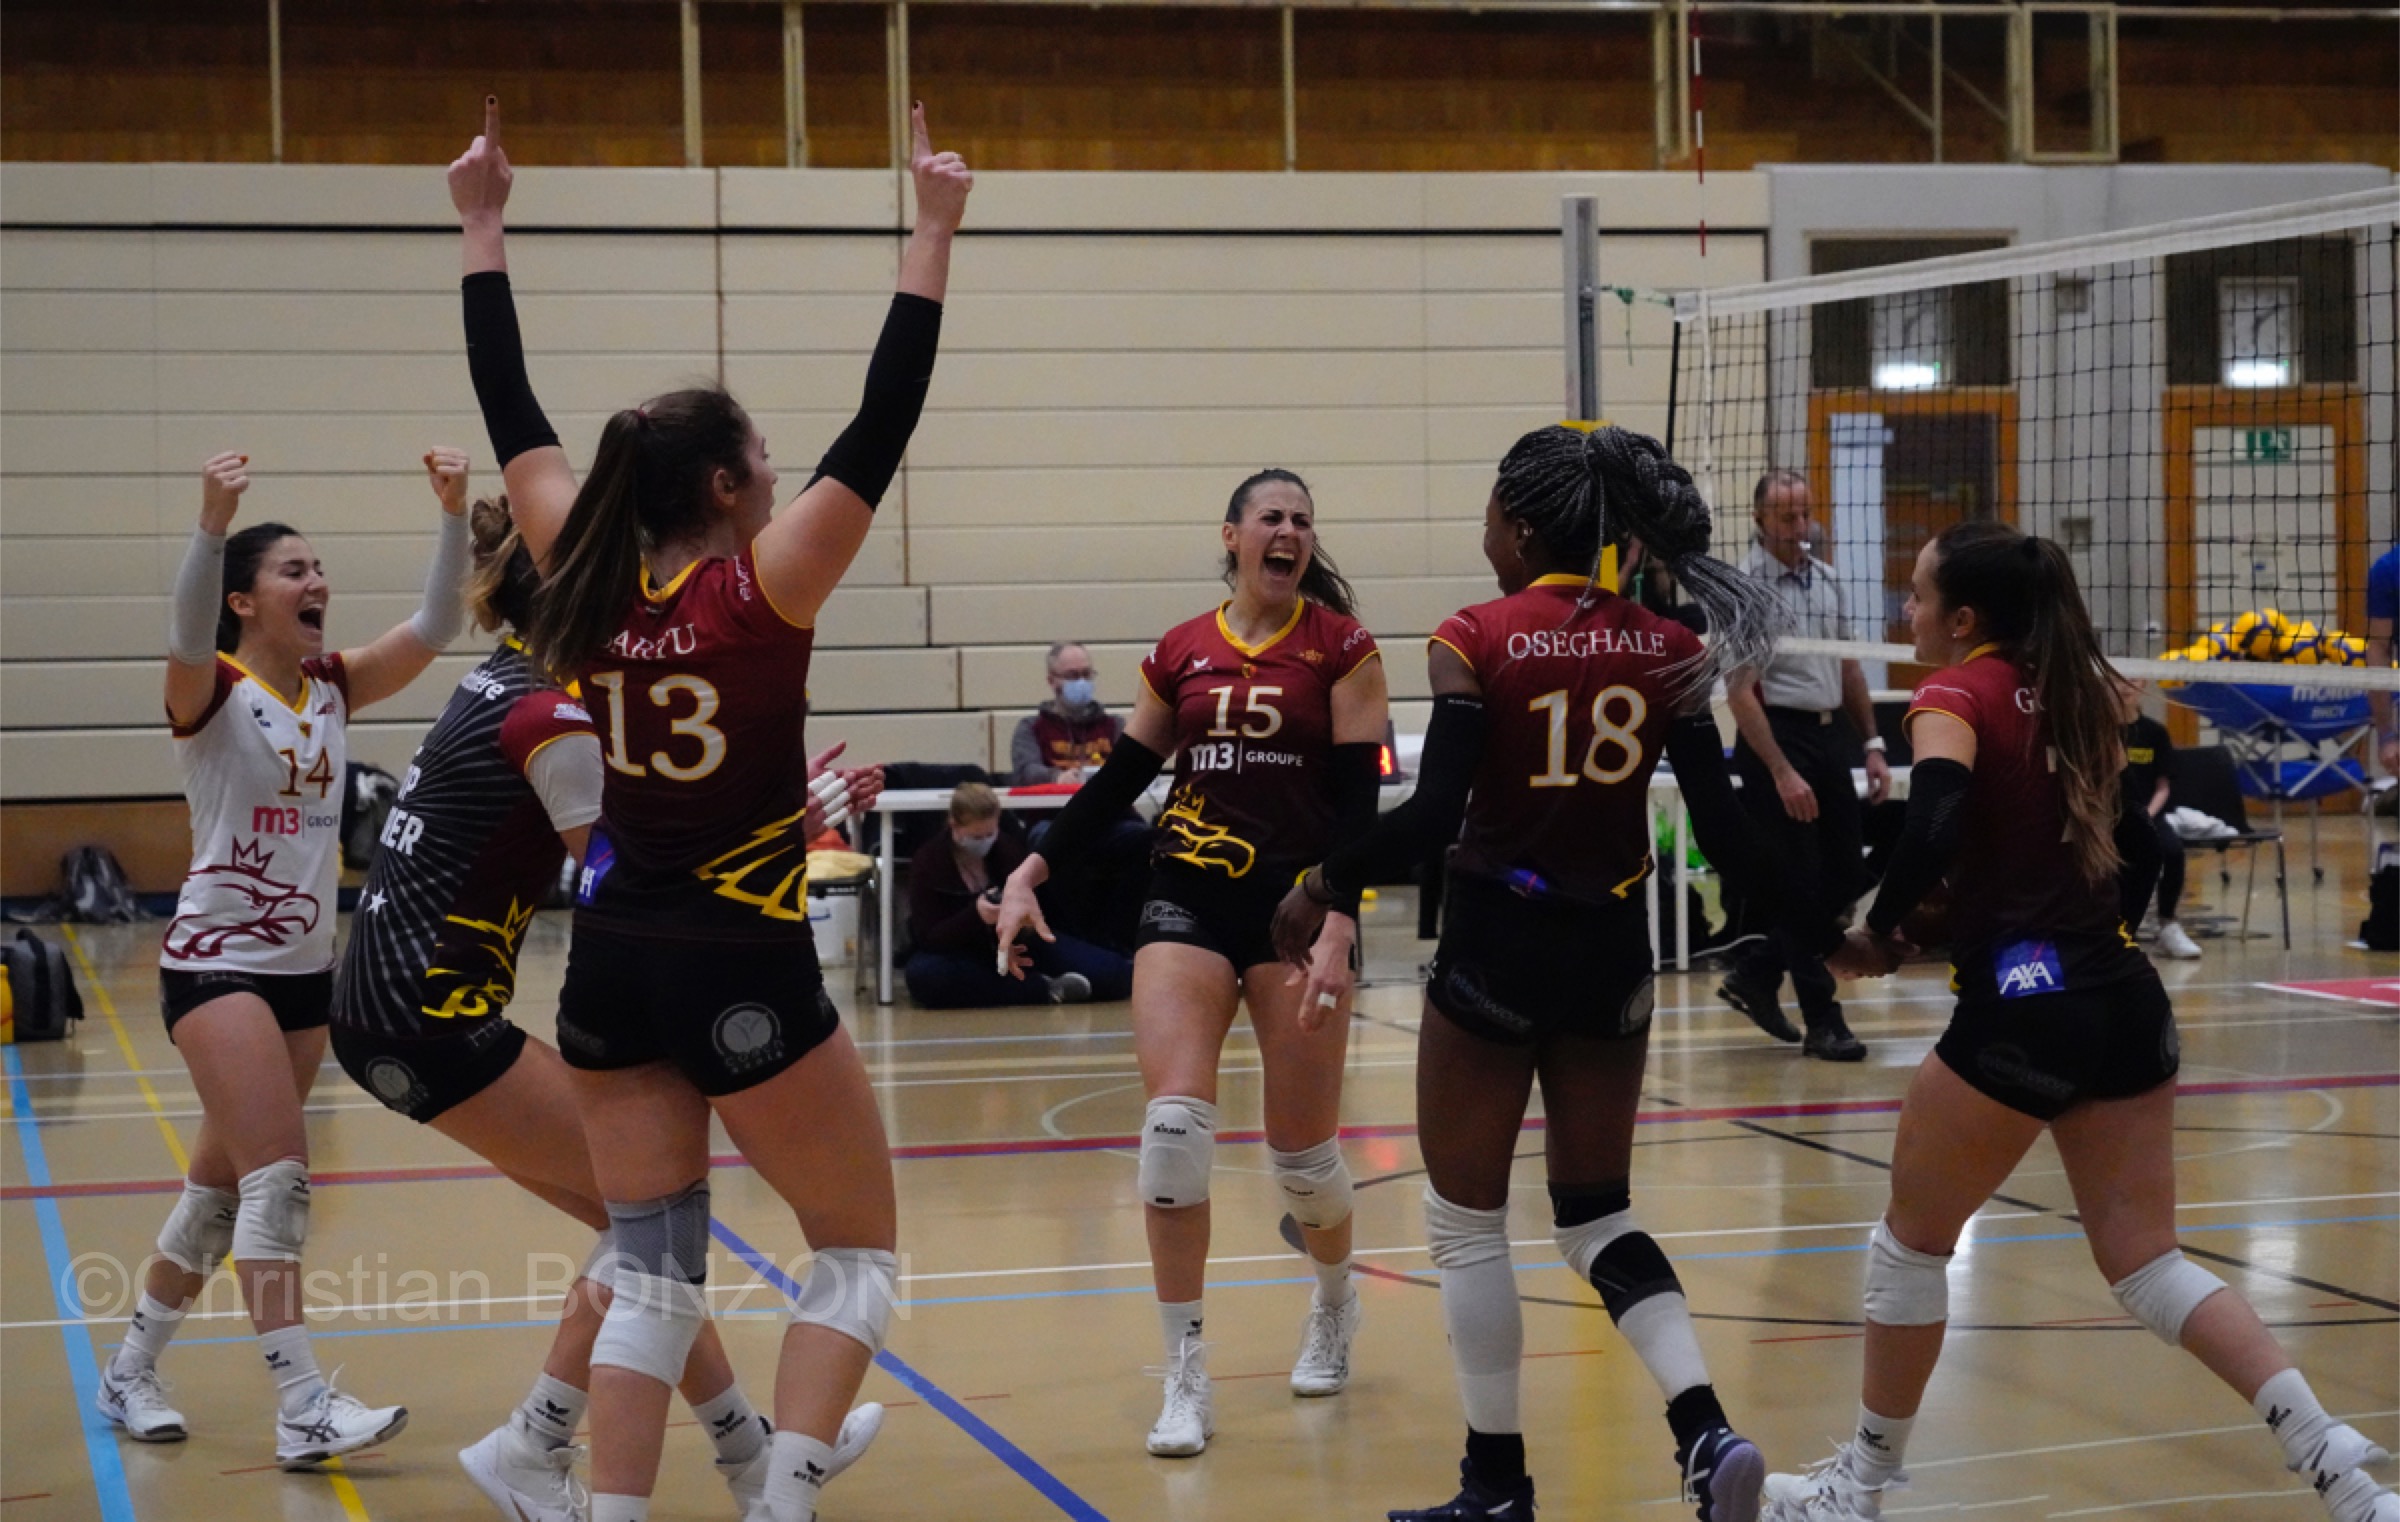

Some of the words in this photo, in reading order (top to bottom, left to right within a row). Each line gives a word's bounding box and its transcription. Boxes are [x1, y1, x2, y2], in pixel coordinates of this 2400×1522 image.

[1507, 628, 1667, 659] OSEGHALE
[590, 670, 727, 782] 13
[1206, 685, 1284, 738] 15
[1190, 743, 1234, 771] m3
[1245, 749, 1303, 767] GROUPE
[1528, 683, 1647, 788] 18
[278, 746, 334, 798] 14
[251, 805, 300, 834] m3
[1999, 960, 2054, 994] AXA
